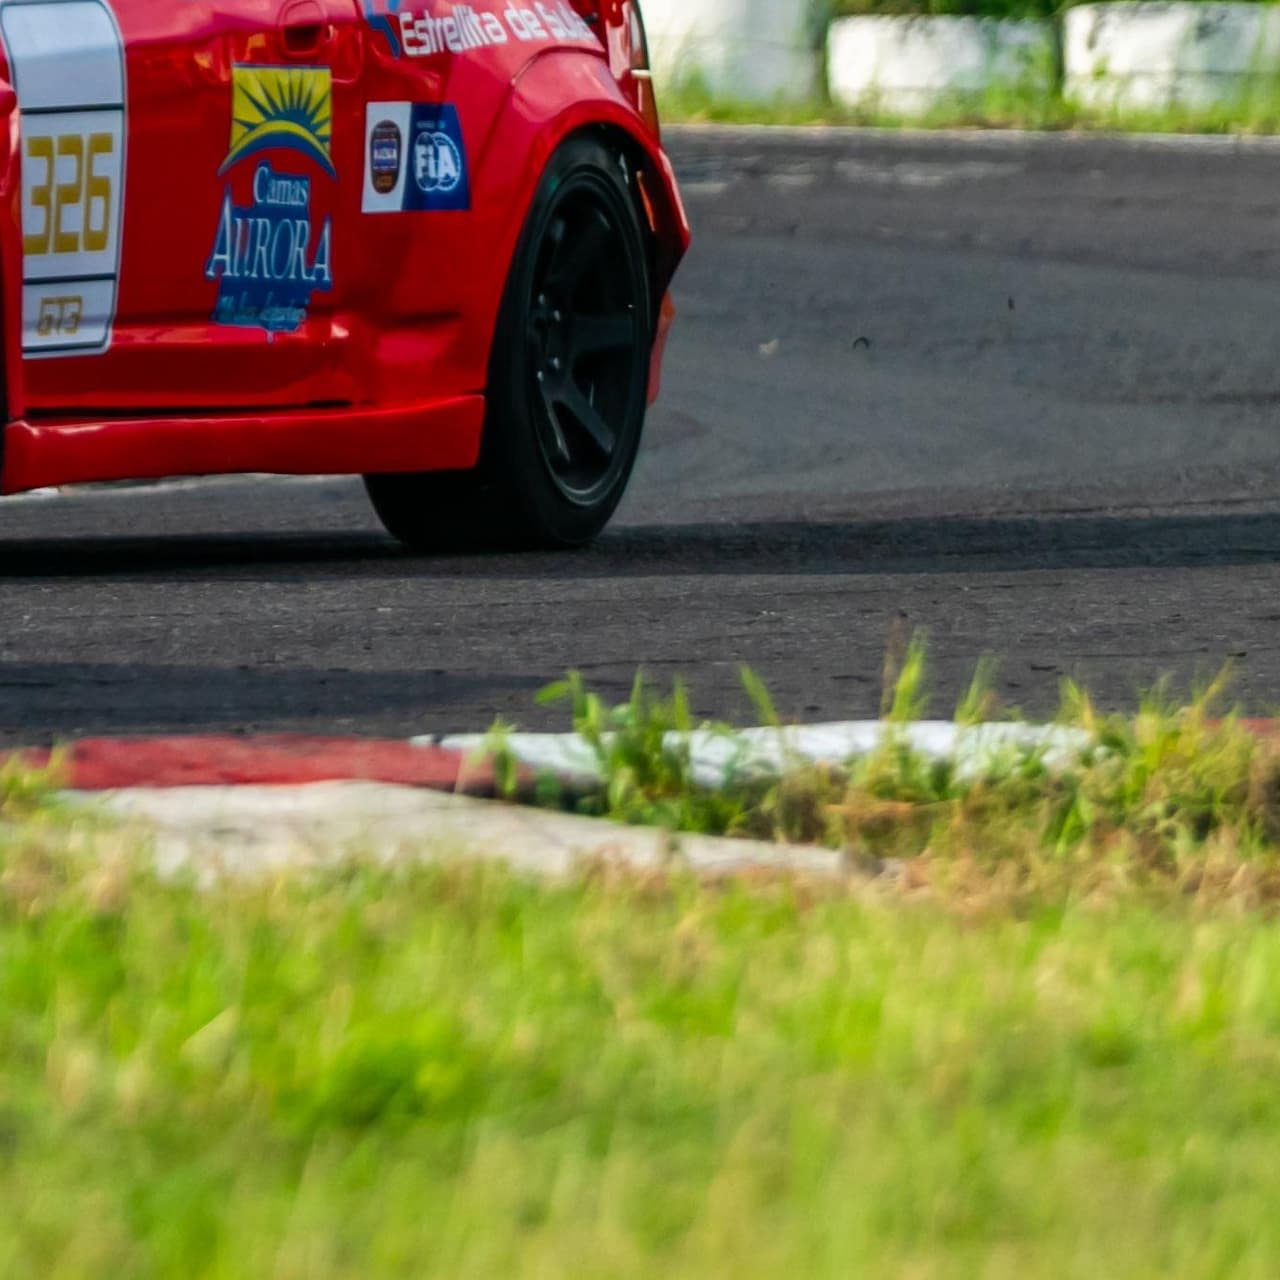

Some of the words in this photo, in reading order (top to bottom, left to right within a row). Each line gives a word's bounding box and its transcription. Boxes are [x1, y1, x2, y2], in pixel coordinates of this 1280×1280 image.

[399, 4, 508, 57] Estrellita
[503, 0, 549, 41] de
[253, 166, 308, 206] Camas
[415, 144, 458, 179] FIA
[23, 132, 114, 257] 326
[206, 194, 332, 281] AURORA
